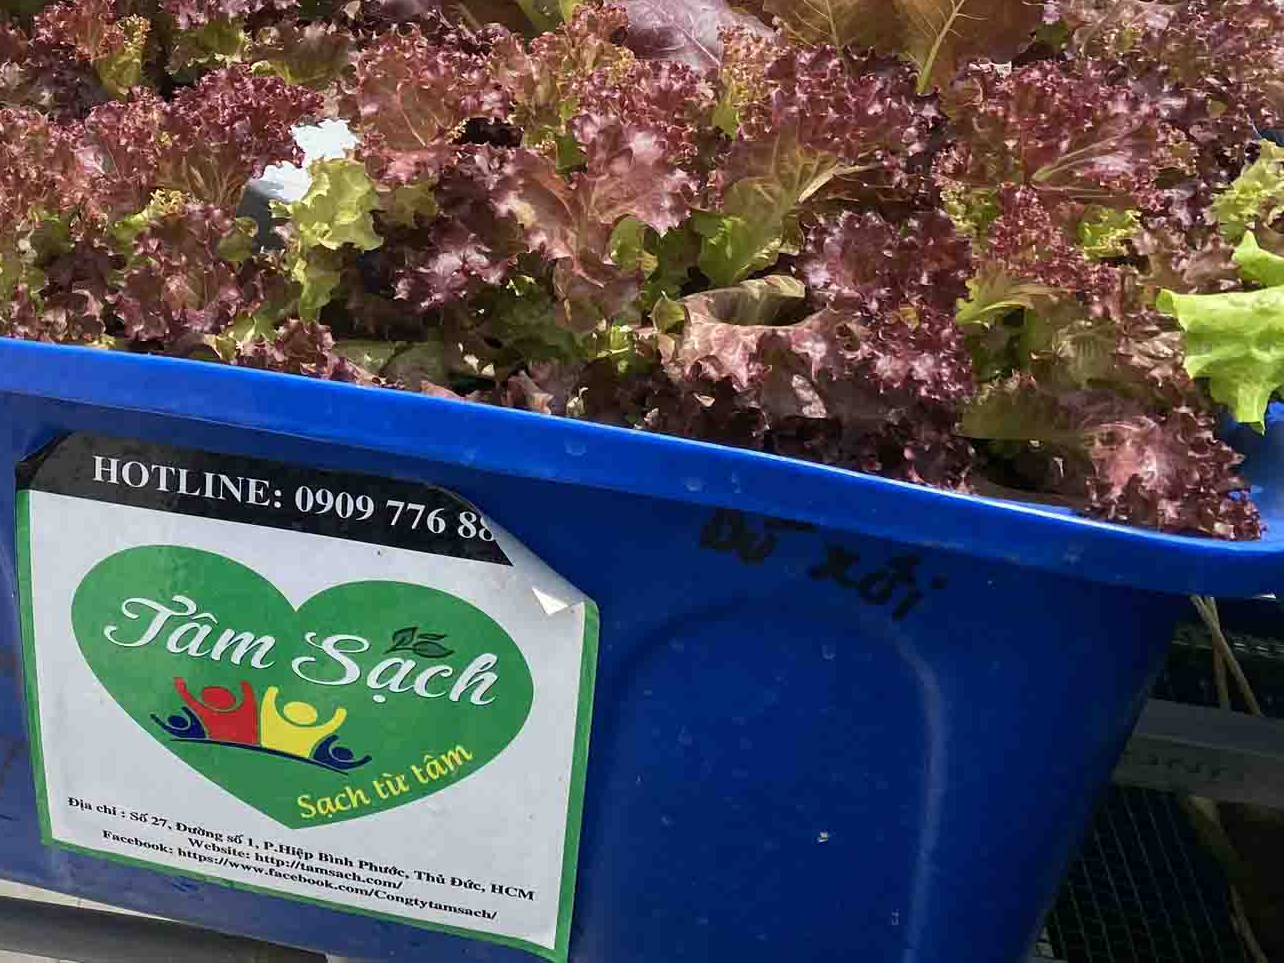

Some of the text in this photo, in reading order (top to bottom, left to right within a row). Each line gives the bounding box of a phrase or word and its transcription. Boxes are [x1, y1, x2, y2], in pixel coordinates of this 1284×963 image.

[92, 455, 283, 509] HOTLINE:
[294, 485, 375, 522] 0909
[386, 499, 445, 534] 776
[103, 595, 277, 670] Tâm
[291, 632, 500, 706] Sạch
[297, 744, 473, 818] Sạch từ tâm
[67, 797, 92, 812] Địa
[96, 803, 117, 816] chỉ
[129, 812, 148, 823] Số
[151, 816, 172, 830] 27,
[176, 822, 223, 843] Đường
[226, 833, 243, 845] số
[248, 838, 259, 849] 1,
[264, 841, 314, 861] P.Hiệp
[318, 850, 354, 868] Bình
[358, 859, 409, 879] Phước,
[414, 870, 445, 885] Thủ
[450, 877, 486, 893] Đức,
[491, 884, 536, 902] HCM
[102, 830, 500, 920] Facebook: https://www.facebook.com/Congtytamsach/
[188, 837, 404, 890] Website: http://tamsach.com/
